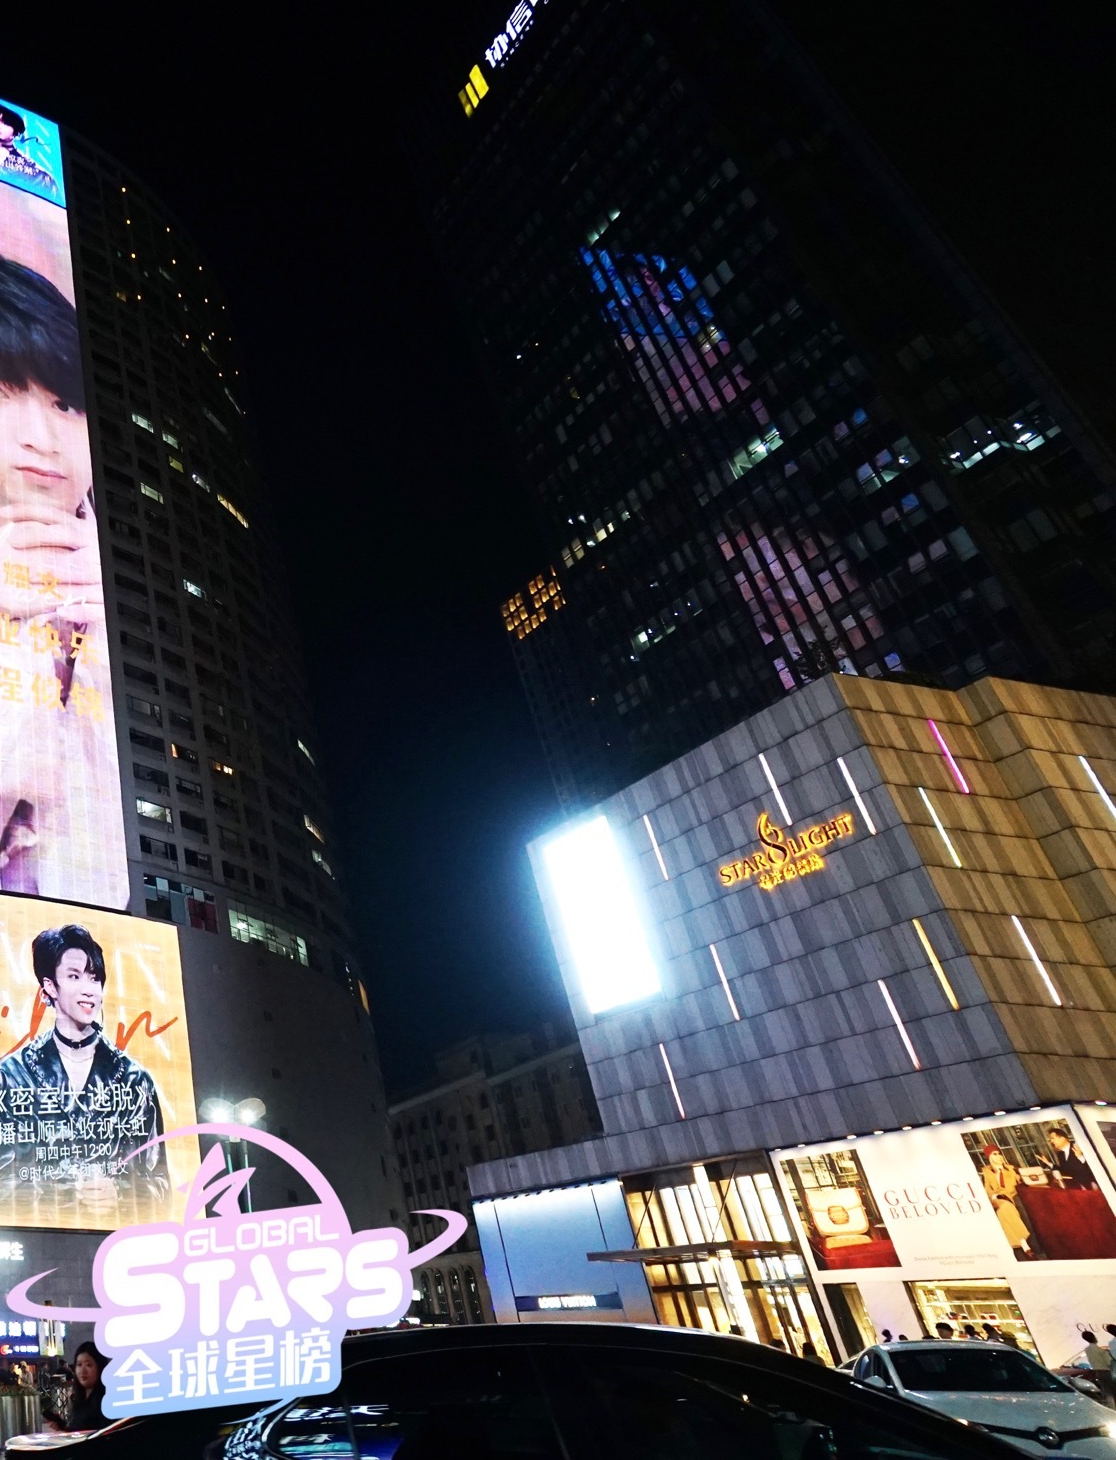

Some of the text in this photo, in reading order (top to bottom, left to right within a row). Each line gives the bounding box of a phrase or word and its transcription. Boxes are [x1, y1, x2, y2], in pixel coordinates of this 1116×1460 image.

[80, 1117, 149, 1141] 收视长虹
[884, 1182, 977, 1207] GUCCI
[889, 1200, 982, 1220] BELOVED
